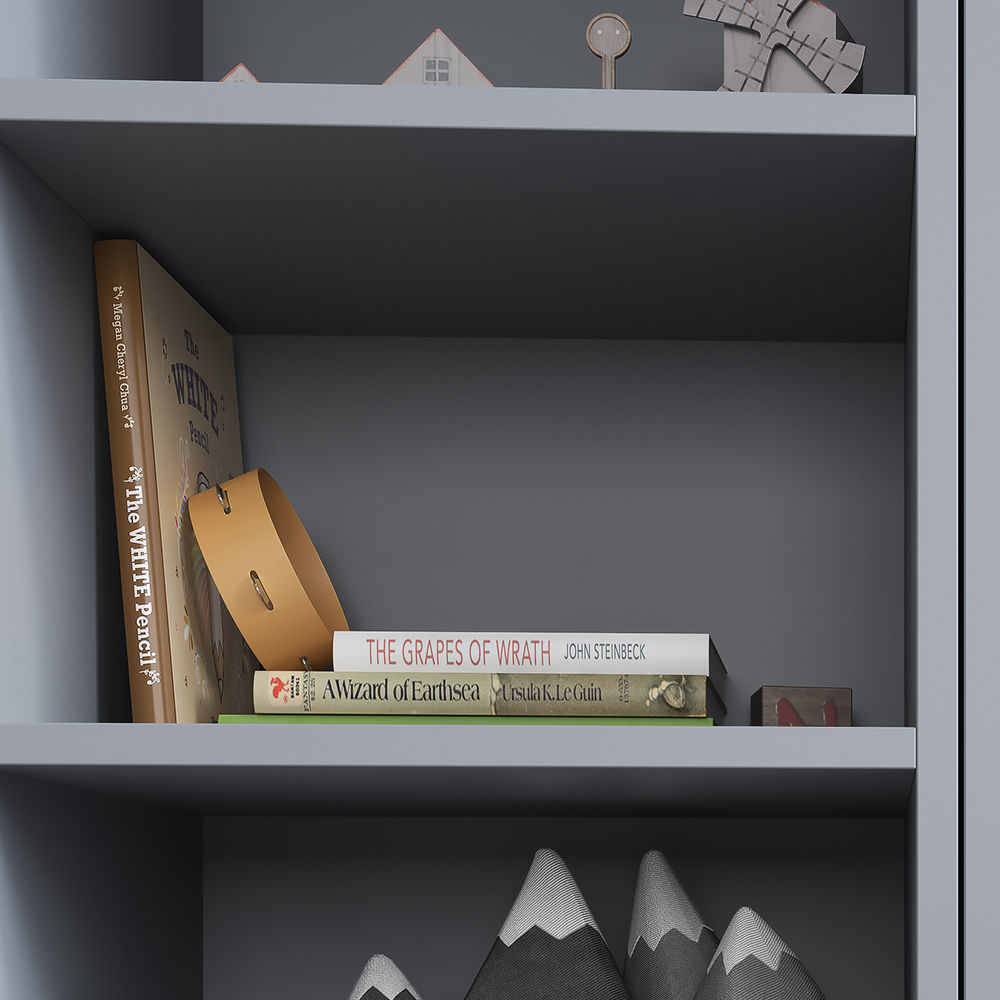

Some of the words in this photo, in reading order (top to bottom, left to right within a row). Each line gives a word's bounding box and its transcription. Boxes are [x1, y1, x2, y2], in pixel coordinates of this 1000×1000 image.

[112, 302, 123, 341] Megan
[116, 343, 129, 381] Cheryl
[184, 328, 200, 360] The
[120, 383, 130, 411] Chua
[171, 362, 219, 438] WHITE
[189, 419, 210, 455] Pencil
[126, 486, 143, 523] The
[128, 526, 151, 597] WHITE
[135, 602, 157, 667] Pencil
[366, 639, 397, 665] THE
[402, 639, 463, 666] GRAPES
[469, 639, 491, 666] OF
[496, 640, 551, 666] WRATH
[563, 643, 591, 660] JOHN
[594, 643, 647, 660] STEINBECK
[393, 678, 410, 701] of
[411, 679, 481, 702] Earthsea
[502, 683, 540, 701] Ursula
[541, 684, 555, 701] K.
